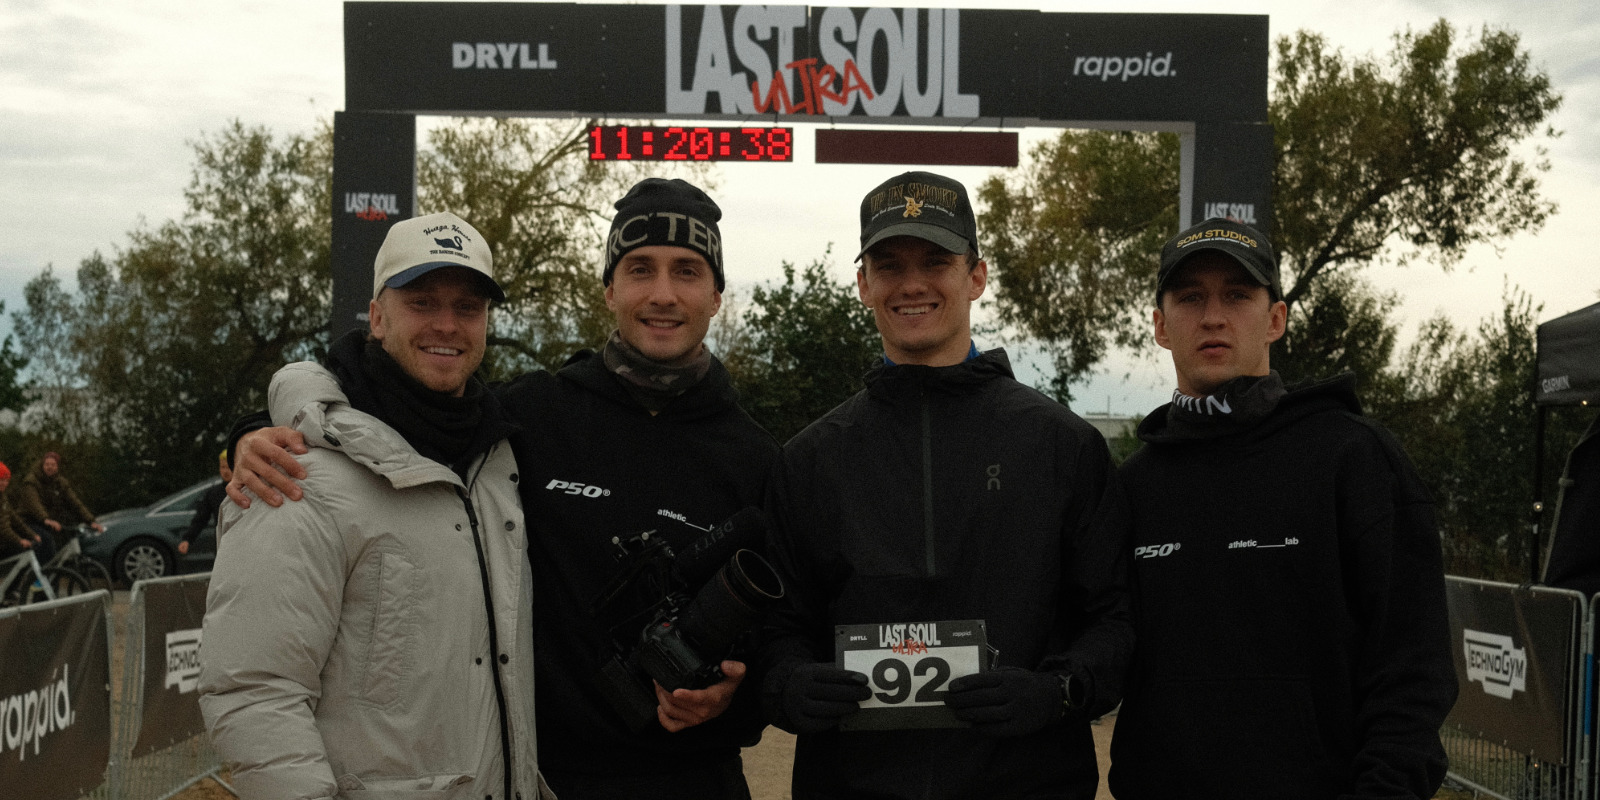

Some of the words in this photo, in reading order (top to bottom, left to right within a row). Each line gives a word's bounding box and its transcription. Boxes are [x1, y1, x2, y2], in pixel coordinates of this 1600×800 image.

[452, 42, 558, 70] DRYLL
[665, 4, 808, 114] LAST
[819, 6, 980, 117] SOUL
[1073, 52, 1178, 82] rappid.
[752, 57, 874, 115] ULTRA
[590, 126, 792, 161] 11:20:38
[345, 192, 370, 214] LAST
[371, 193, 399, 215] SOUL
[1204, 202, 1229, 220] LAST
[1229, 203, 1257, 224] SOUL
[606, 211, 722, 270] RC'TER
[1177, 232, 1203, 248] SOM
[1204, 229, 1258, 248] STUDIOS
[879, 624, 907, 648] LAST
[908, 622, 942, 646] SOUL
[872, 656, 951, 705] 92
